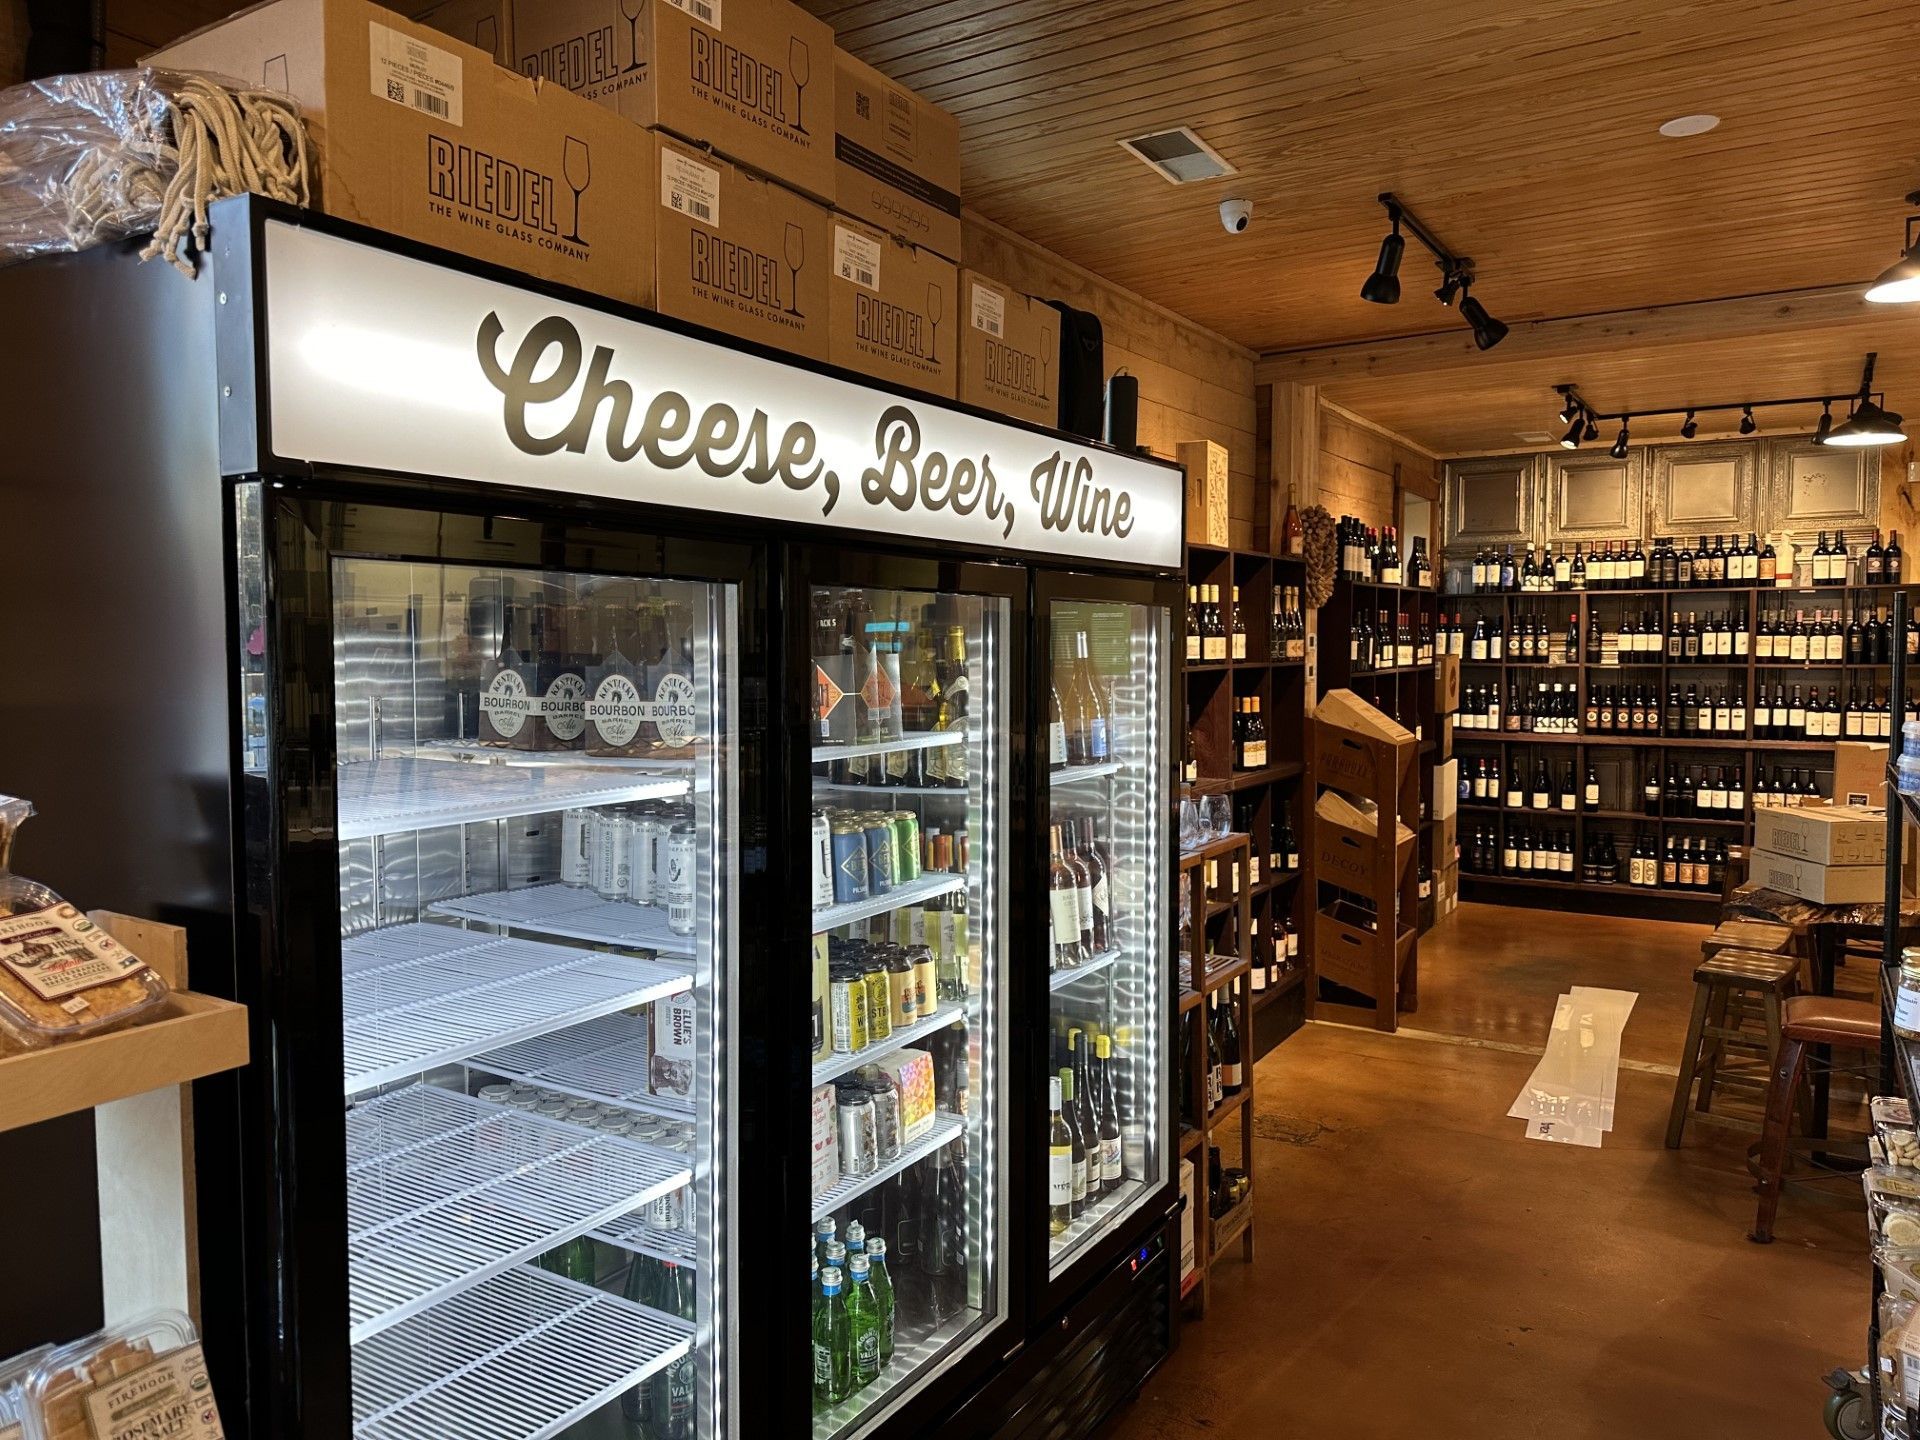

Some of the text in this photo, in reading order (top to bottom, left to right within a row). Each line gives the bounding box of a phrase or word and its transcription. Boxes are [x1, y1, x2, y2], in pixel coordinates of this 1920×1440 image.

[602, 71, 648, 95] COMPANY
[691, 27, 785, 123] RIEDEL
[691, 85, 811, 149] THE WINE GLASS COMPANY
[428, 134, 557, 235] RIEDEL
[429, 202, 590, 262] THE WINE GLASS COMPANY
[691, 228, 780, 310] RIEDEL
[692, 286, 805, 331] THE WINE GLASS COMPANY
[856, 292, 924, 358] RIEDEL
[856, 342, 942, 376] THE WINE GLASS COMPANY
[985, 340, 1036, 396] RIEDEL
[476, 310, 1135, 540] Cheese, Beer, Wine
[492, 673, 524, 694] KENTUCKY
[599, 679, 635, 700] KENTUCKY
[658, 678, 694, 700] KENTUCKY
[484, 697, 530, 711] BOURBON
[541, 701, 585, 712] BOURBO
[590, 705, 645, 717] BOURBON
[652, 705, 695, 717] BOURBO
[1321, 851, 1368, 875] DECOY
[673, 1008, 682, 1046] BROWN
[108, 1371, 175, 1409] FIREHOOK
[152, 1417, 184, 1438] SALT
